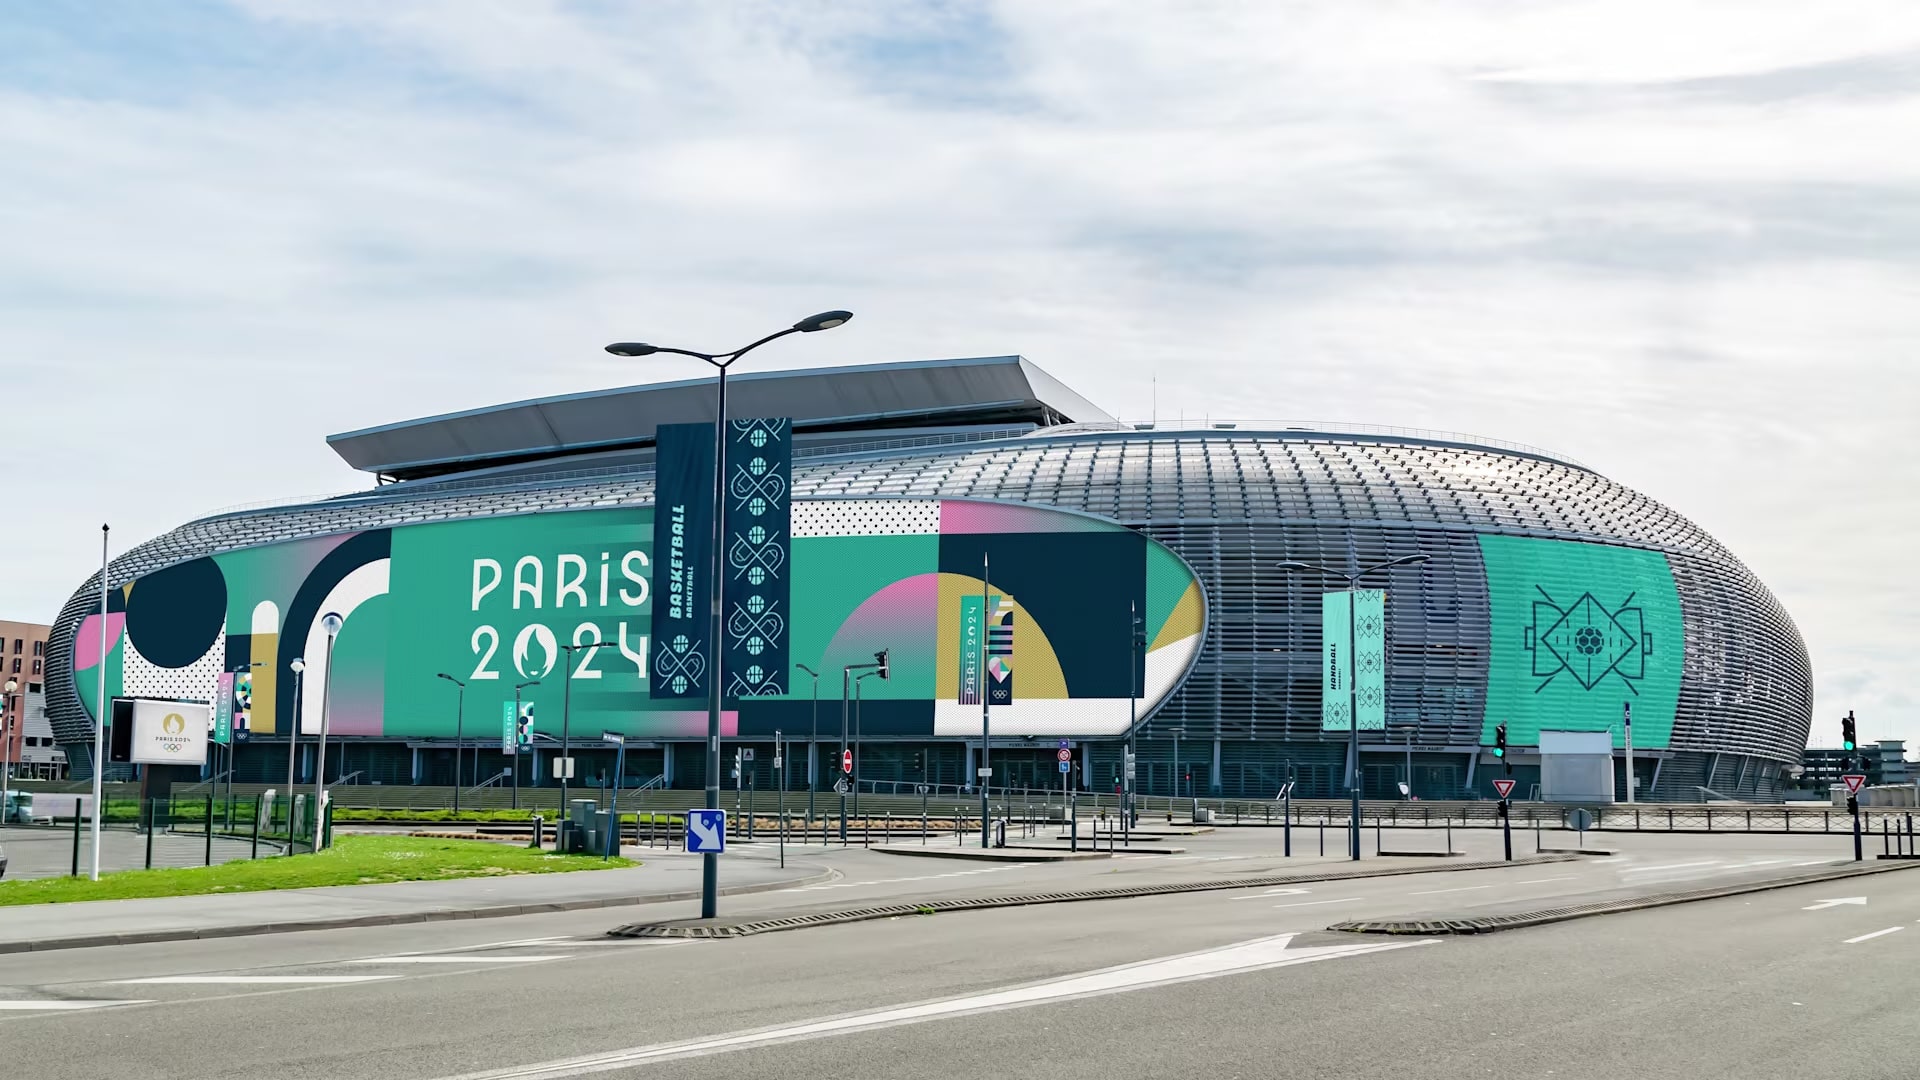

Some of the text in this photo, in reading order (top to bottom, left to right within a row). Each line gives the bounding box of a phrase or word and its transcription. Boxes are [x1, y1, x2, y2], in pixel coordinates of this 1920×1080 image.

[669, 504, 685, 619] BASKETBALL
[685, 566, 694, 618] BASKETBALL
[469, 621, 648, 680] 2024
[967, 606, 977, 645] 2024
